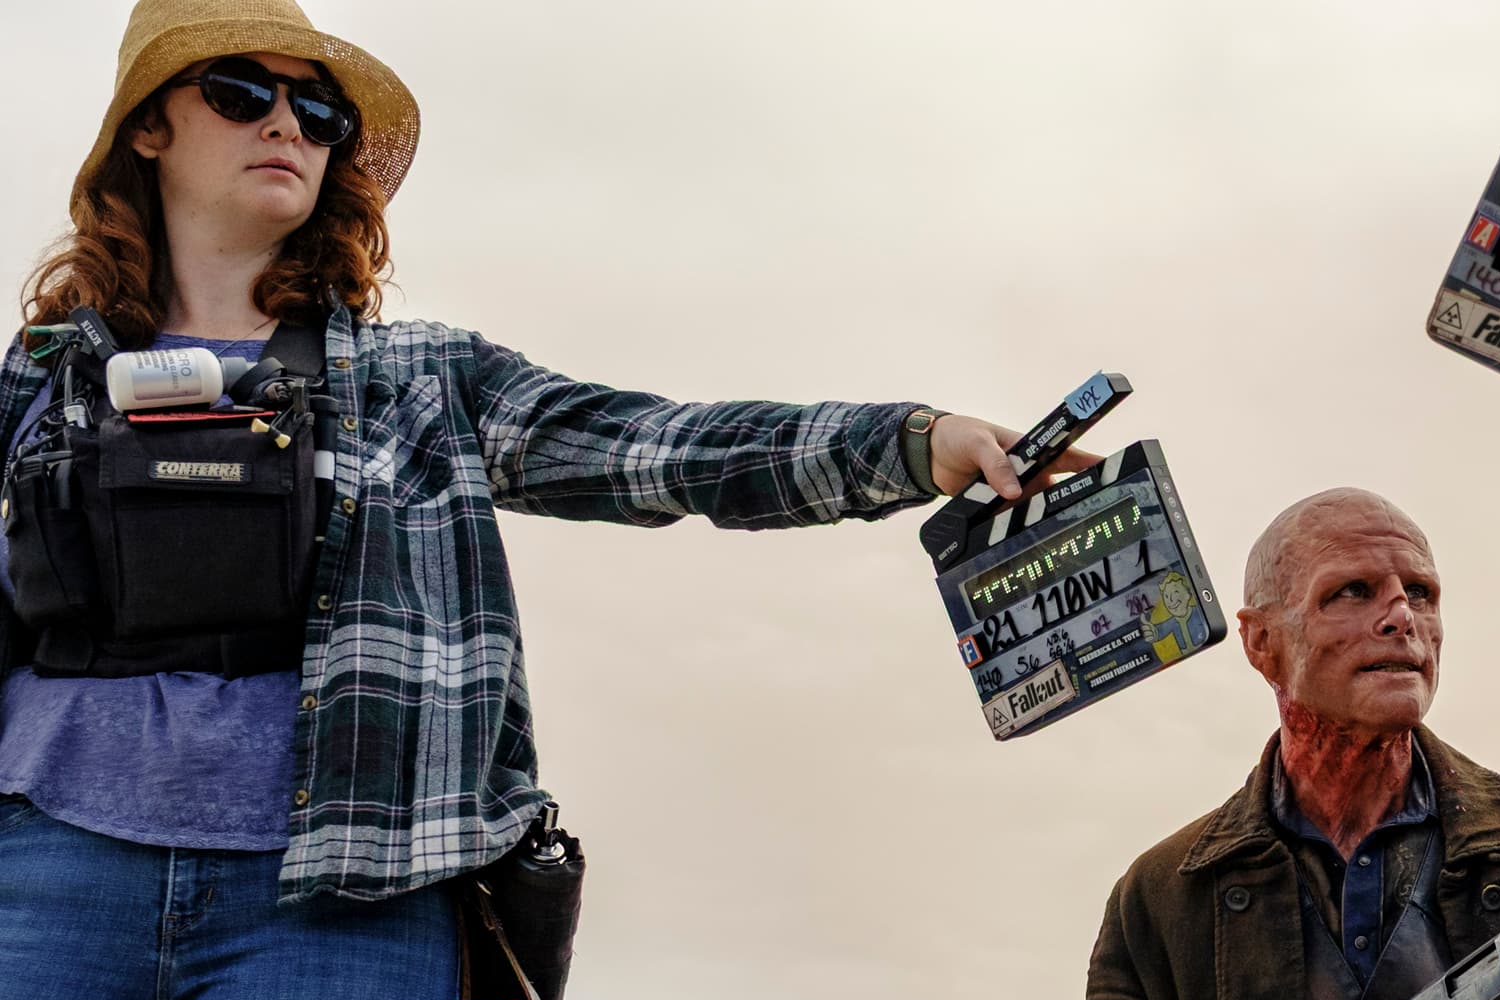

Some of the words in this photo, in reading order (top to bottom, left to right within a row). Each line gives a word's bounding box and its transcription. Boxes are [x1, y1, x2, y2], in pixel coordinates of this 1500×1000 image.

[1473, 222, 1496, 249] A
[1025, 442, 1040, 459] OP:
[1038, 417, 1068, 448] SERGIUS
[156, 461, 242, 477] CONTERRA
[1129, 539, 1167, 585] 1
[1031, 556, 1113, 634] 110W
[1008, 667, 1065, 719] Fallout
